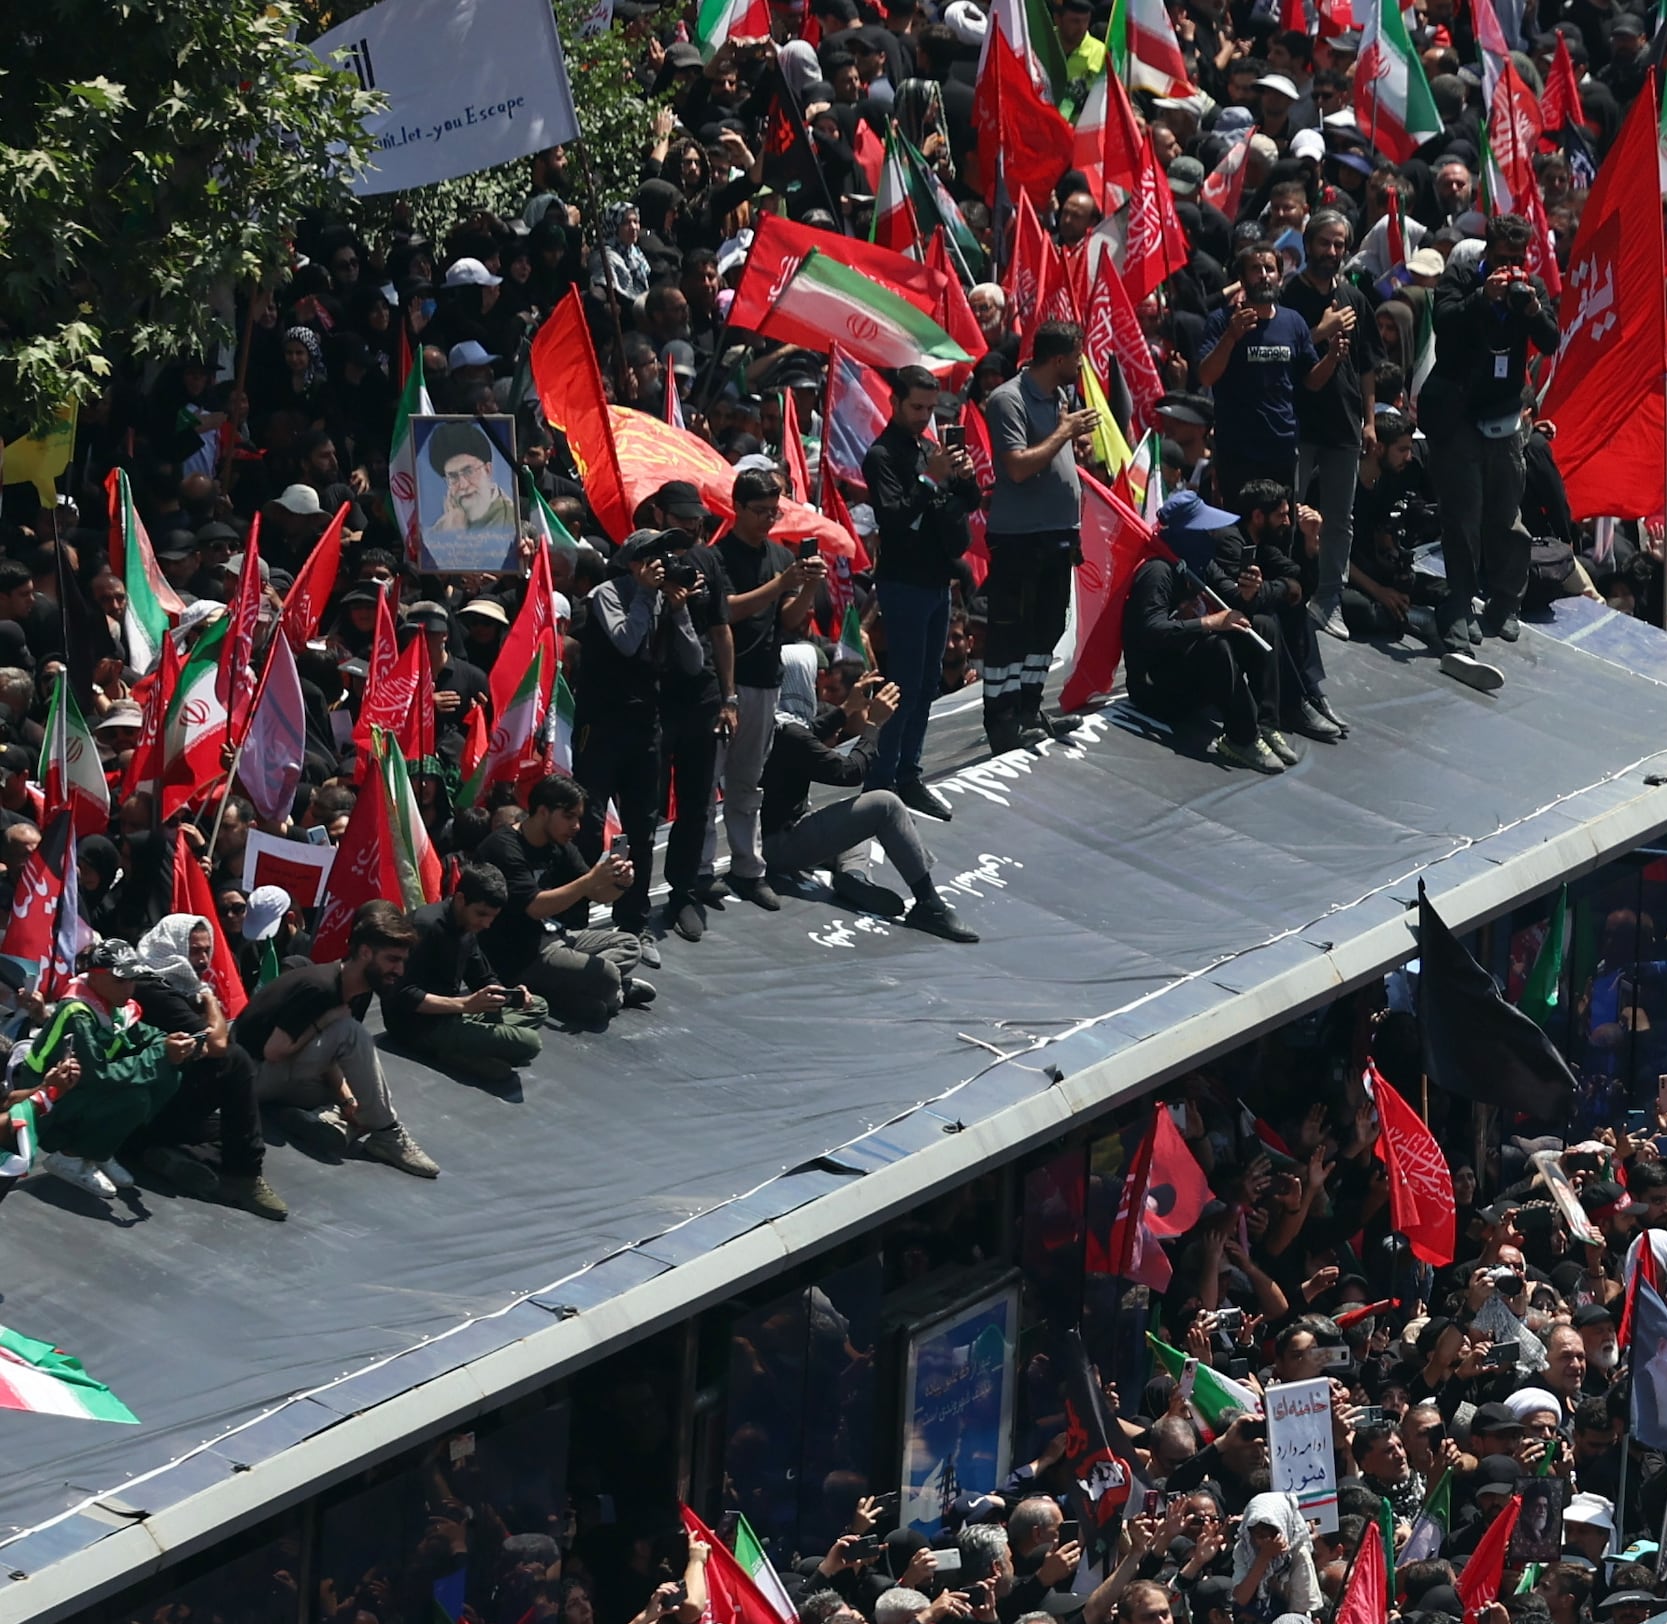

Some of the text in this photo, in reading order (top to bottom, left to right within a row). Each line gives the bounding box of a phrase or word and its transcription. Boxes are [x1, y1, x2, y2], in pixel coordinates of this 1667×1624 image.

[466, 95, 525, 126] Escape
[1276, 1436, 1327, 1461] ادامه دارد
[1283, 1464, 1327, 1492] هنوز
